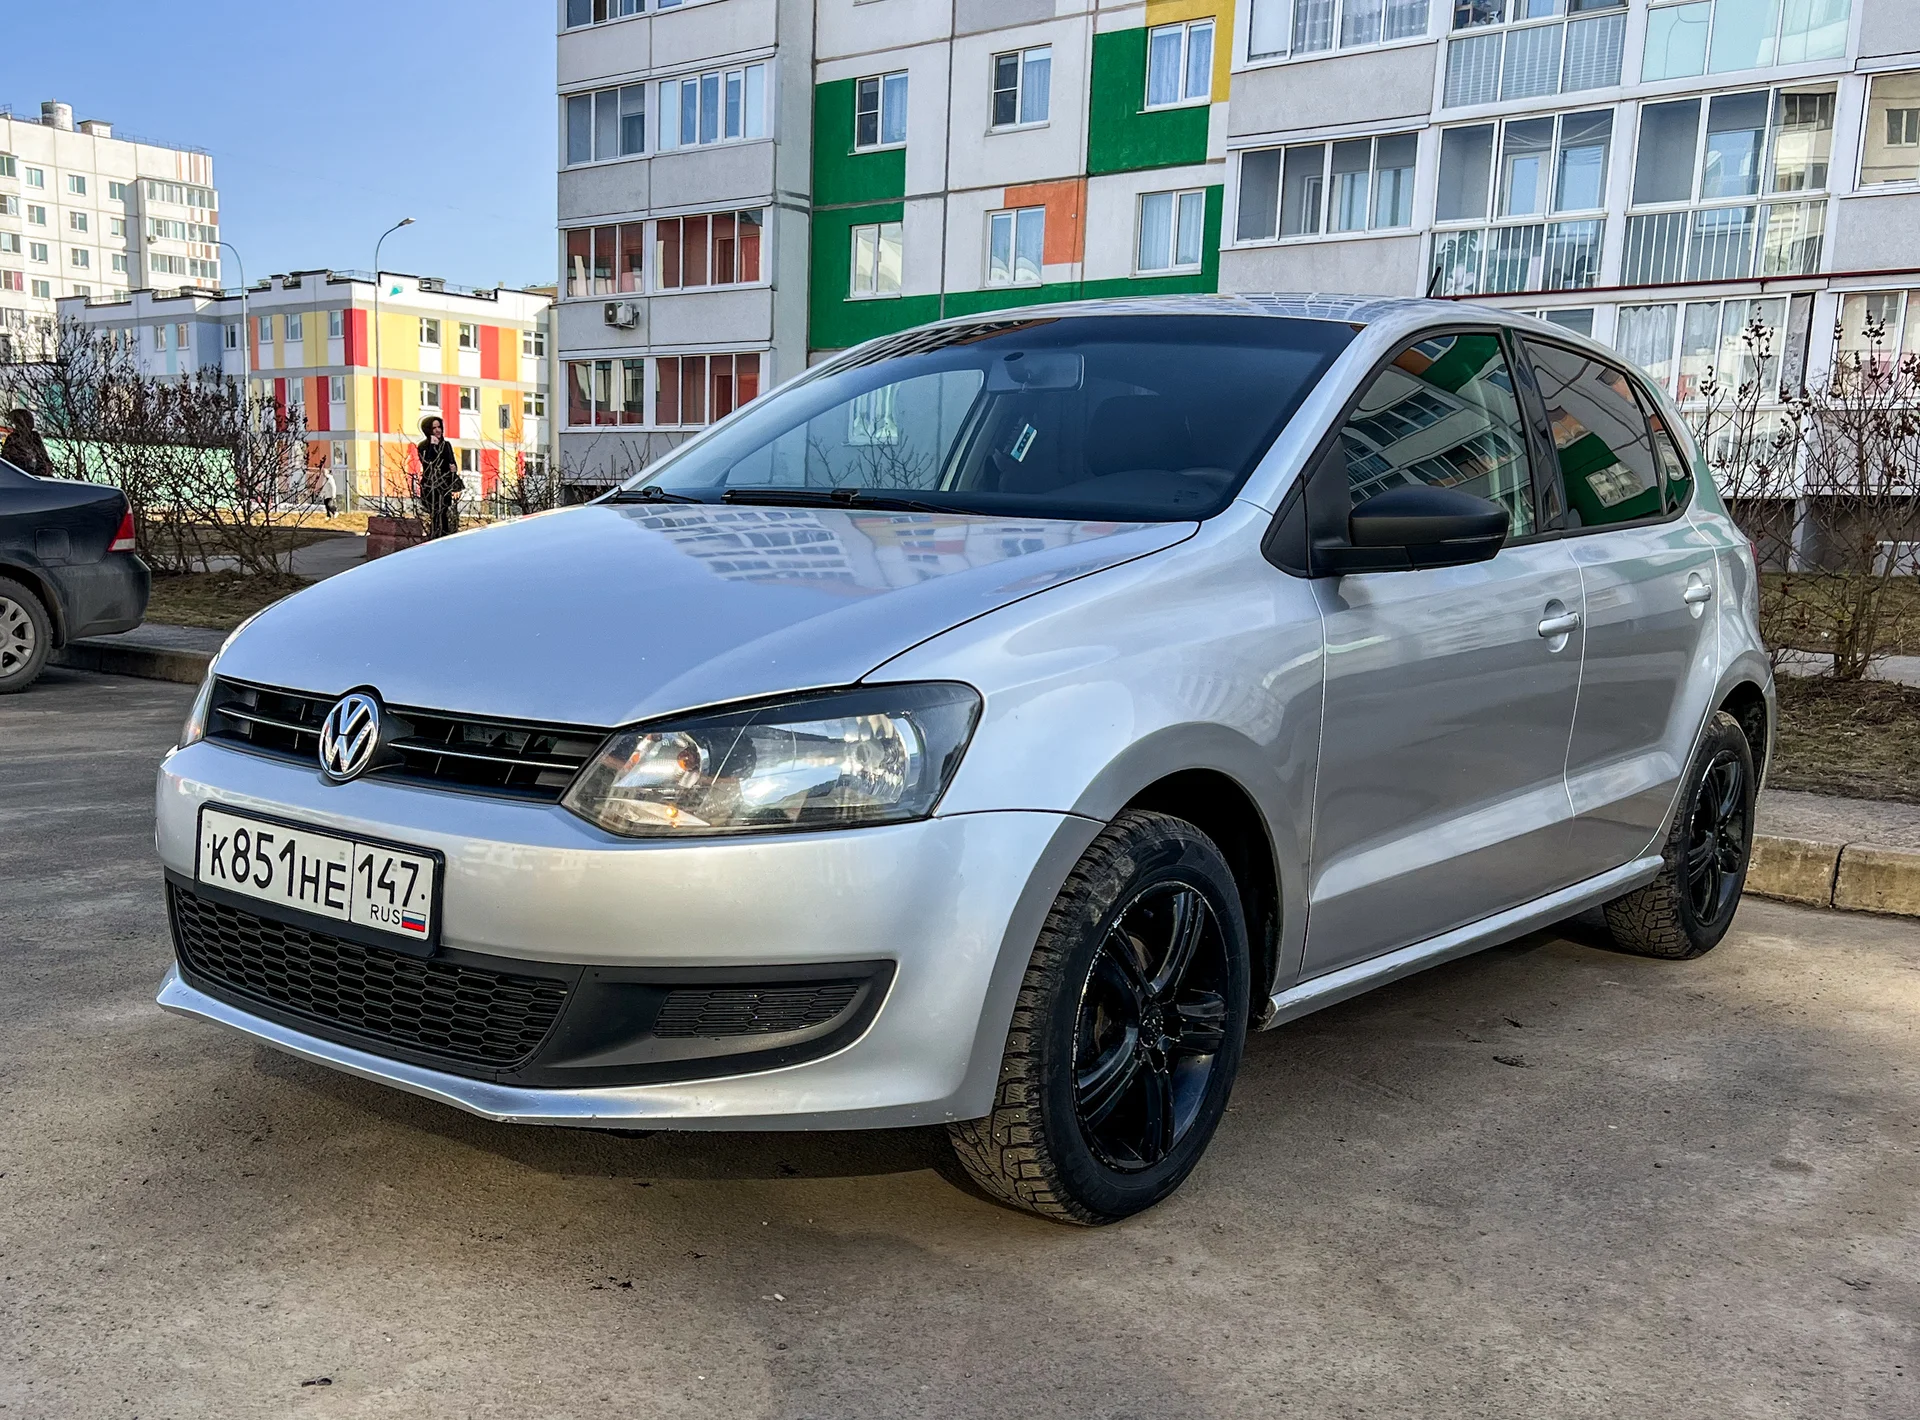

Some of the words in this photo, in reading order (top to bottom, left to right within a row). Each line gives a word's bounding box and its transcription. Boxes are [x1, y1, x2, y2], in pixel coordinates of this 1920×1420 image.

[320, 694, 379, 780] VW
[358, 854, 419, 907] 147
[370, 904, 400, 925] RUS
